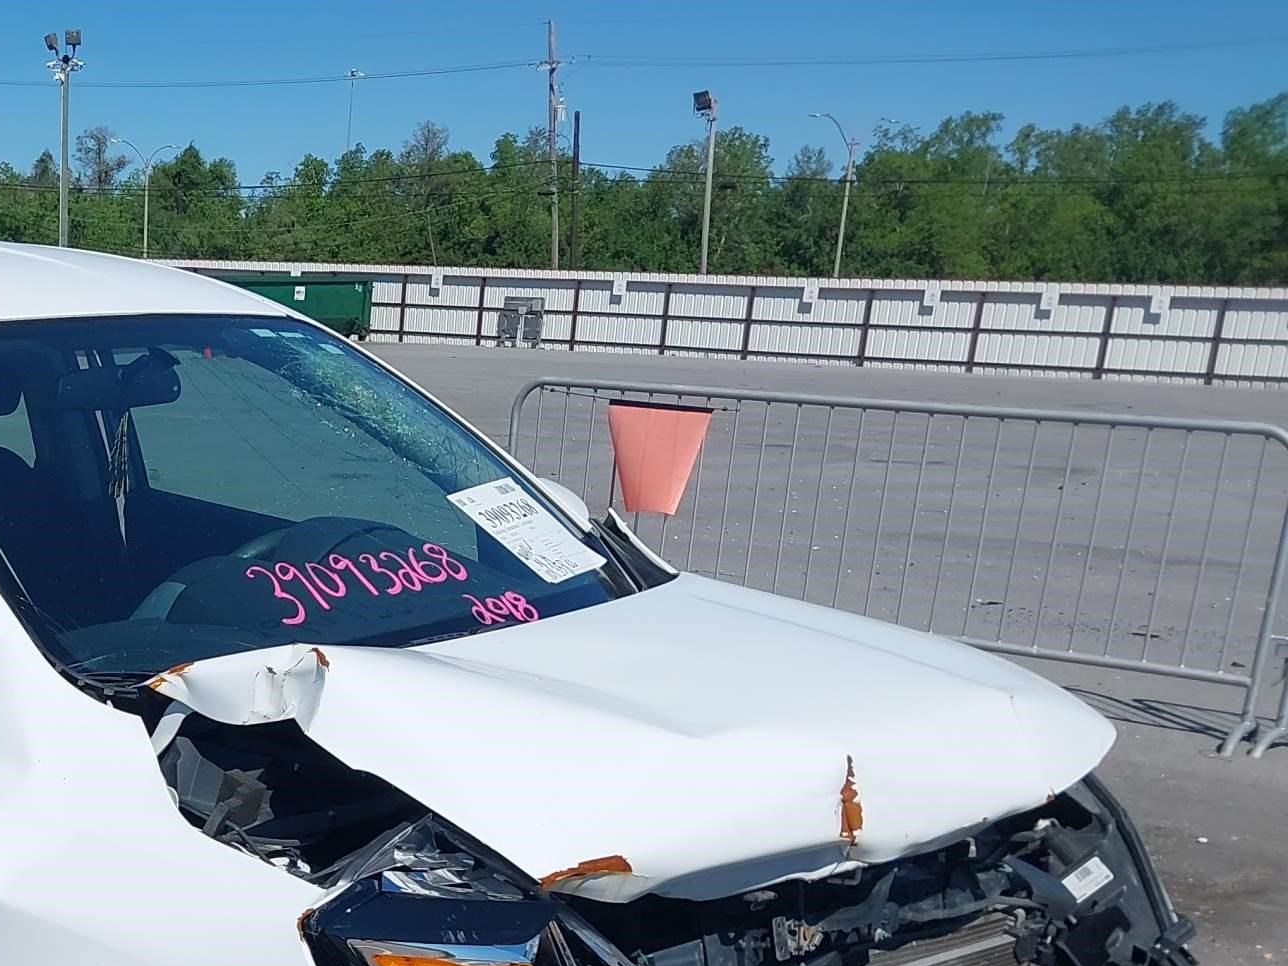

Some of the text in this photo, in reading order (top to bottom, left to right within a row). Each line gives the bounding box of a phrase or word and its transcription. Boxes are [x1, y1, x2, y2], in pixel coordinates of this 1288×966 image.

[478, 498, 539, 529] 39093268
[245, 543, 468, 625] 39093268
[462, 591, 540, 625] 2018
